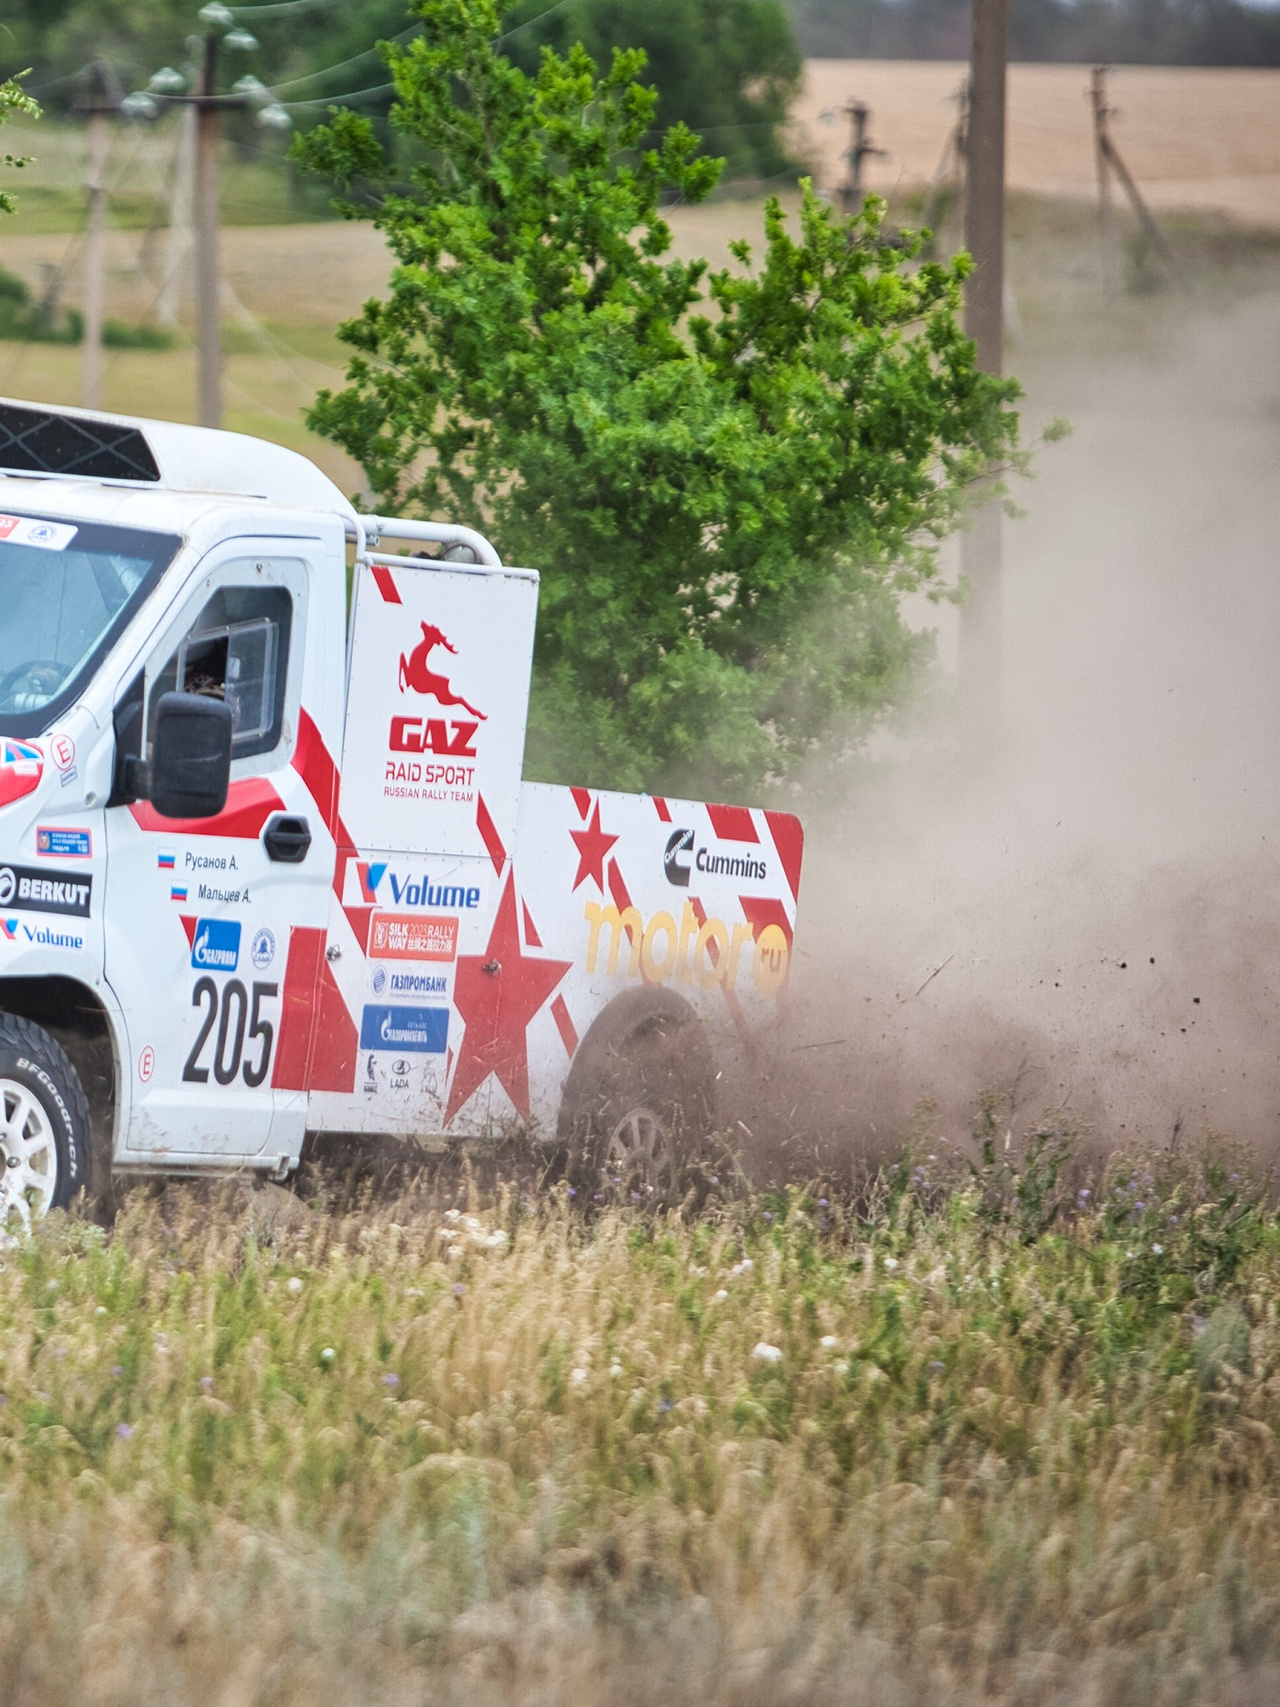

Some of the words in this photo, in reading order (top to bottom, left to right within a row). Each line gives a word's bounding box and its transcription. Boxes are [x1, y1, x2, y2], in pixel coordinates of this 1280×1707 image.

[389, 714, 479, 757] GAZ
[56, 740, 71, 764] E
[385, 761, 422, 782] RAID
[425, 764, 475, 786] SPORT
[383, 786, 419, 799] RUSSIAN
[422, 788, 448, 800] RALLY
[450, 790, 474, 802] TEAM
[185, 851, 226, 871] Русанов
[696, 847, 766, 880] Cummins
[18, 877, 90, 906] BERKUT
[198, 884, 240, 903] Мальцев
[389, 873, 480, 908] Volume
[22, 924, 83, 949] Volume
[389, 922, 409, 936] SILK
[427, 925, 455, 939] RALLY
[389, 936, 407, 950] WAY
[584, 900, 754, 991] motor
[390, 974, 448, 992] ГАЗПРОМБАНК
[182, 975, 279, 1088] 205
[142, 1053, 152, 1075] E
[390, 1078, 409, 1089] LADA
